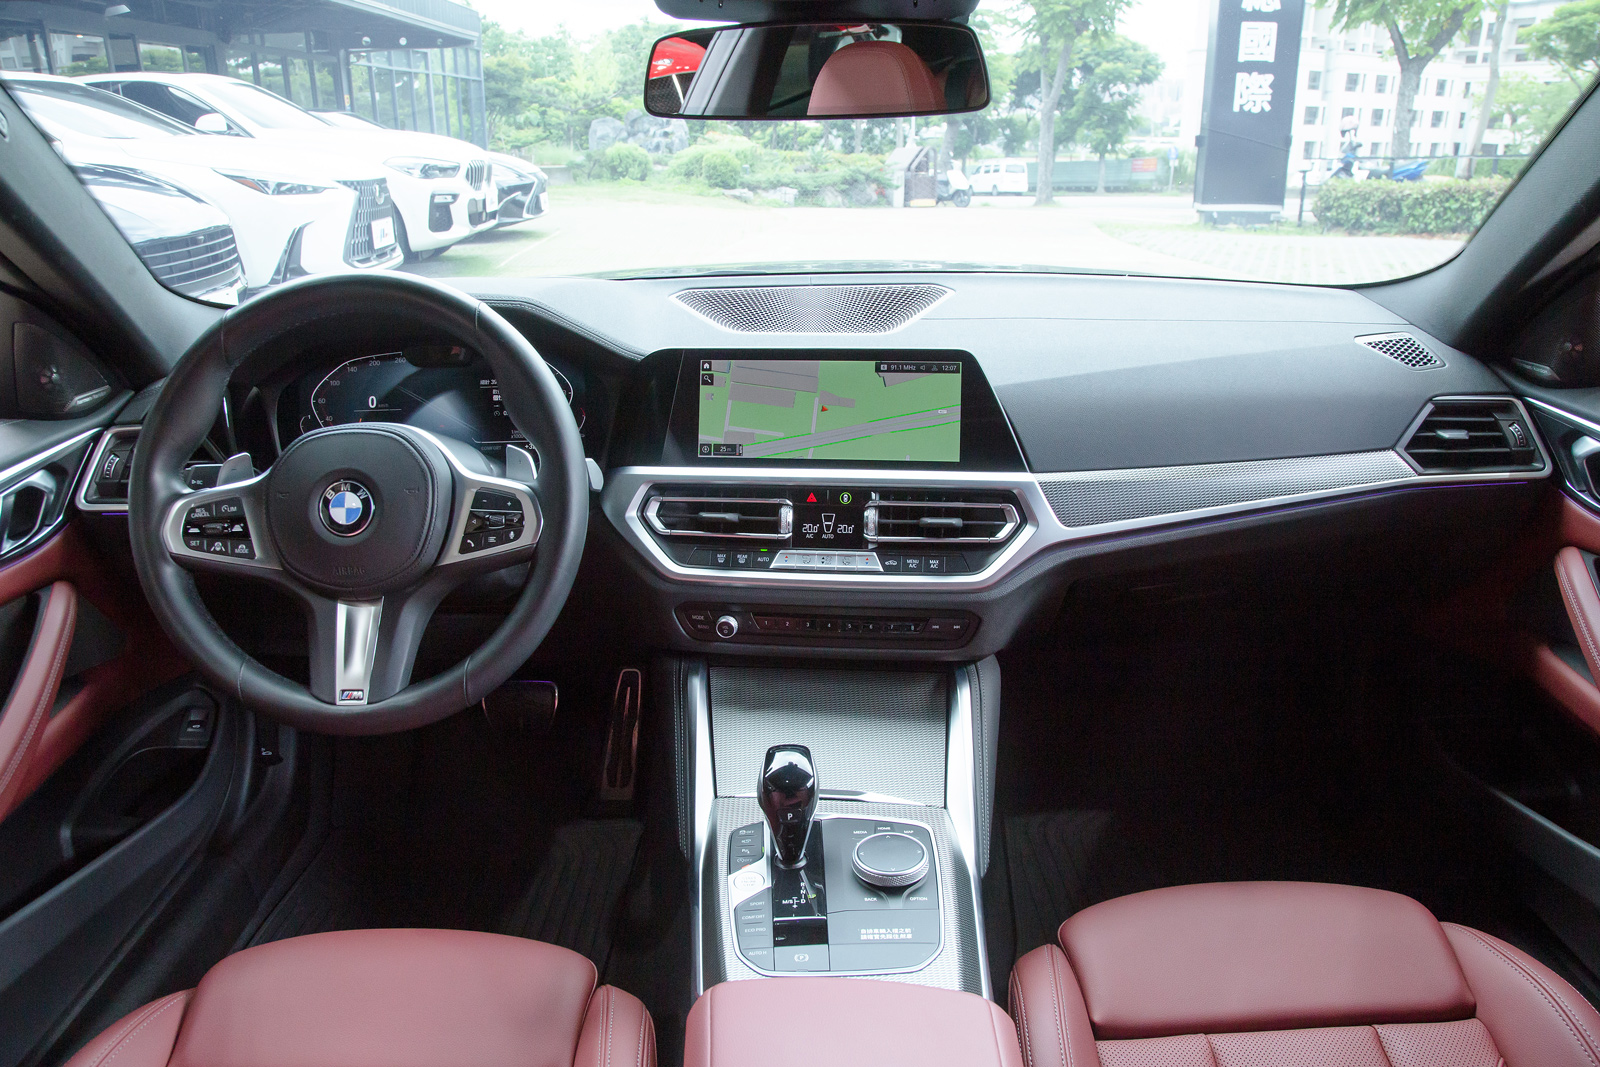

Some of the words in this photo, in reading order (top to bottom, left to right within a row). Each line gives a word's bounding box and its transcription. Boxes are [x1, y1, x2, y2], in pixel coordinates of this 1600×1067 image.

[1233, 0, 1281, 113] 國際
[368, 395, 377, 409] 0
[325, 482, 368, 501] BMW
